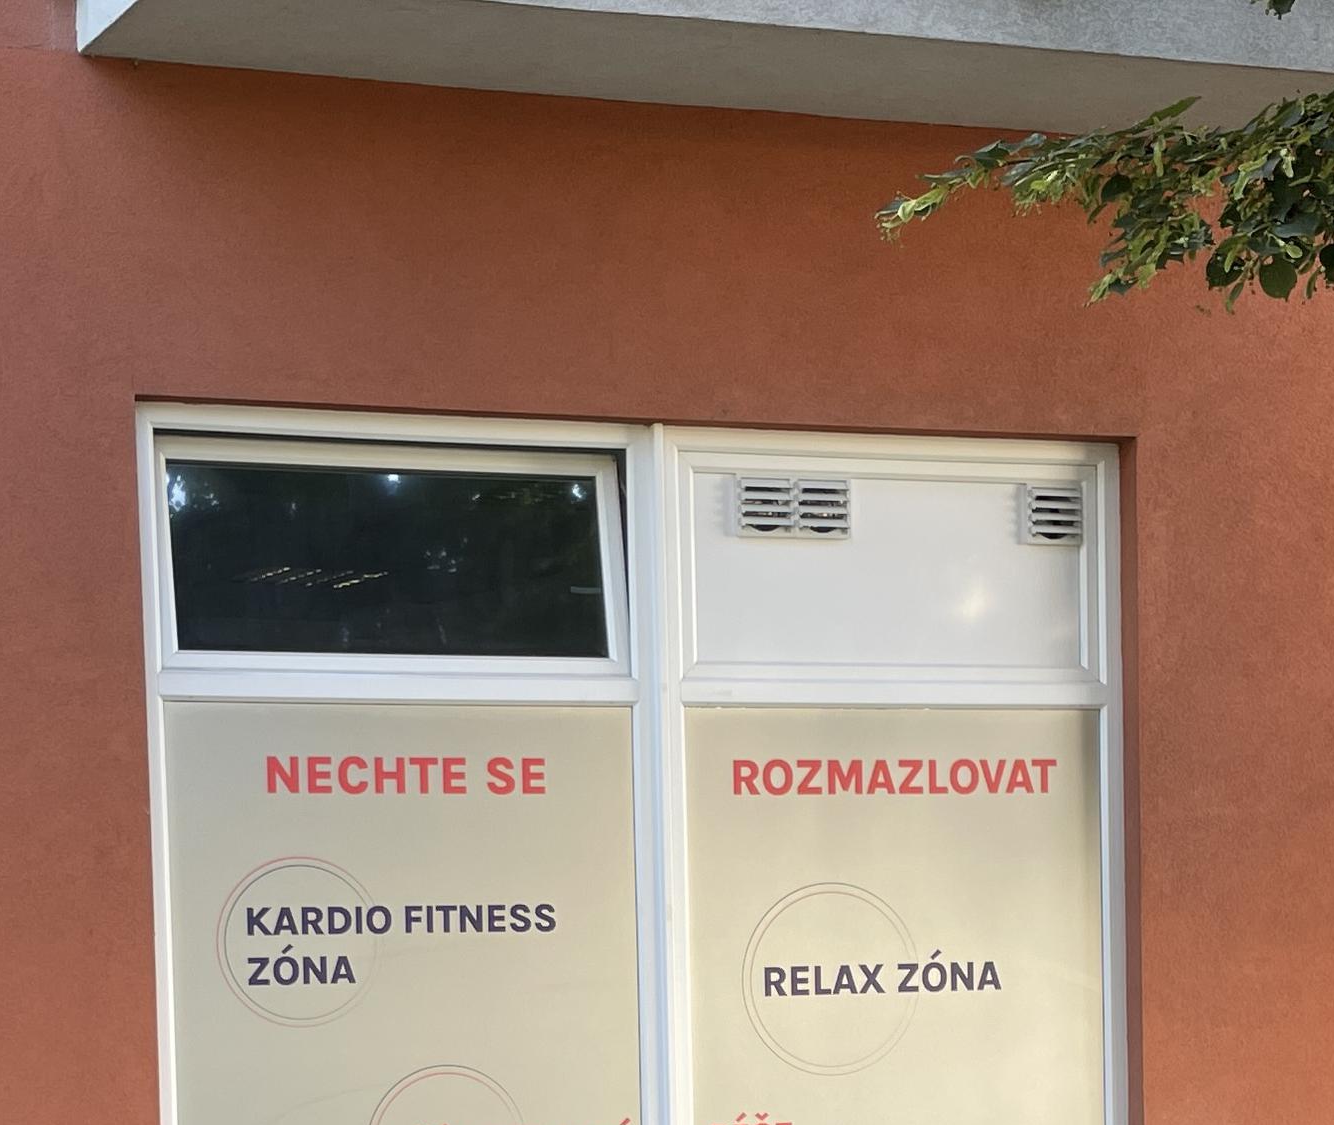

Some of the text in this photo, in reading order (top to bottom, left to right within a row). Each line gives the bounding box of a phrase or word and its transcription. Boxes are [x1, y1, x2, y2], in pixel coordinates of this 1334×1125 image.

[266, 755, 547, 796] NECHTE SE
[731, 758, 1058, 796] ROZMAZLOVAT
[245, 903, 557, 936] KARDIO FITNESS
[247, 943, 357, 986] ZÓNA
[763, 949, 1002, 998] RELAX ZÓNA
